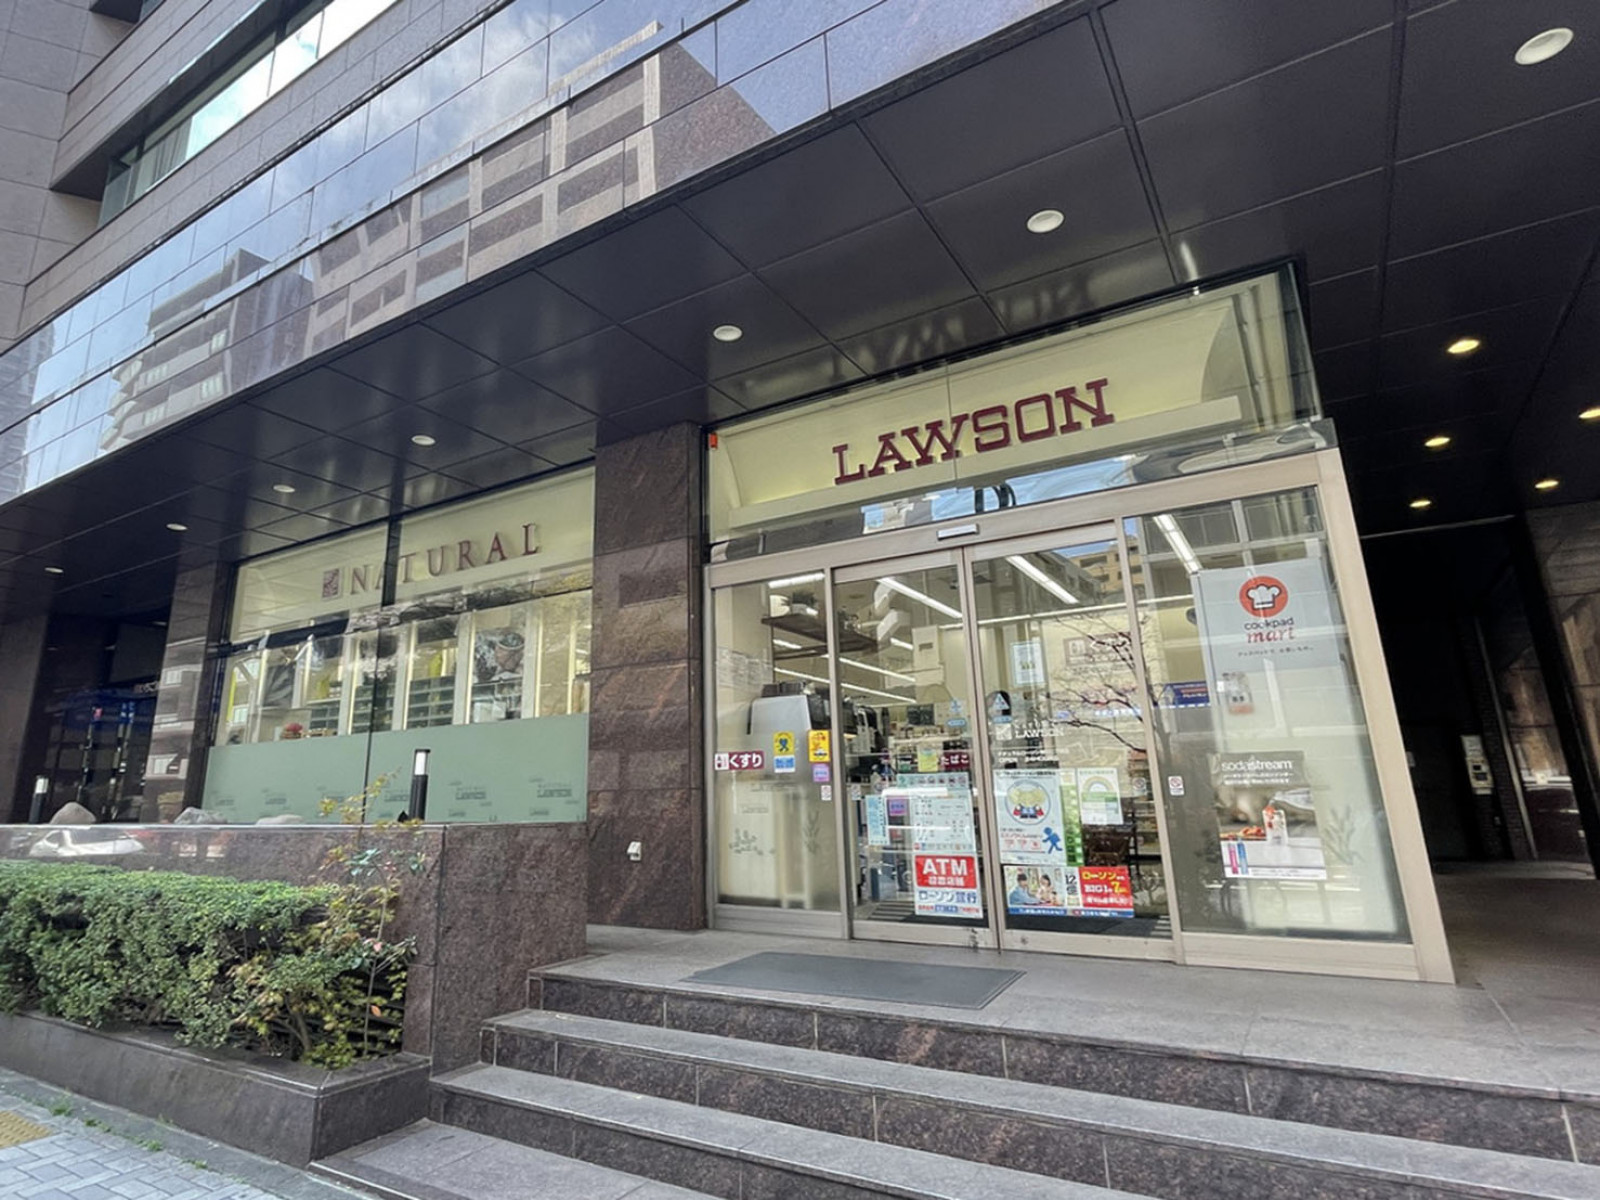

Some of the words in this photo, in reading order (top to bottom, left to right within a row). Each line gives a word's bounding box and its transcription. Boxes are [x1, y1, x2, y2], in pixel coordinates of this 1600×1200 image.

[832, 378, 1115, 485] LAWSON
[729, 752, 763, 768] くすり
[922, 858, 968, 876] ATM
